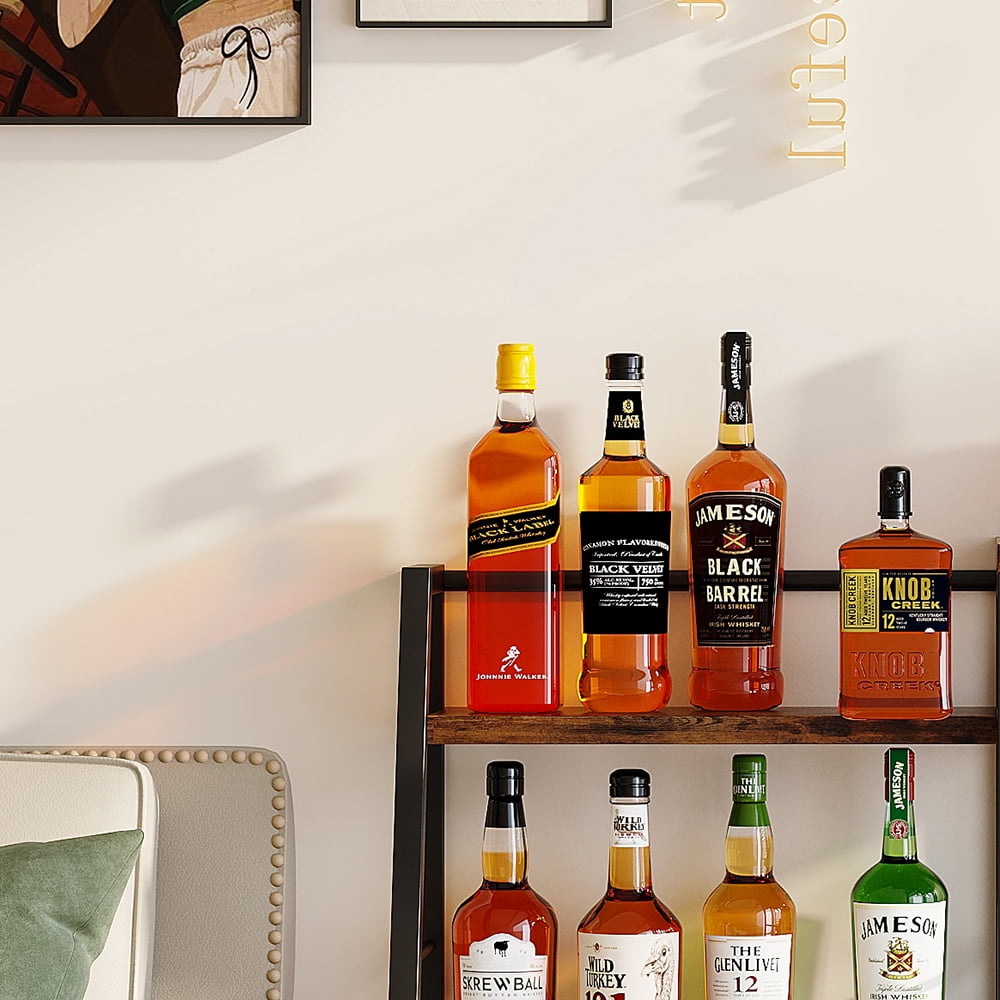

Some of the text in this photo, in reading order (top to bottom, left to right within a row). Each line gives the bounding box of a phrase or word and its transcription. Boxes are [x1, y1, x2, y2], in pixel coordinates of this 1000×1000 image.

[731, 344, 741, 390] JAMESON
[695, 504, 774, 527] JAMESON
[511, 519, 554, 532] LABEL
[589, 565, 630, 574] BLACK
[707, 558, 762, 576] BLACK
[641, 577, 654, 586] 750
[883, 577, 932, 601] KNOB
[706, 585, 764, 603] BARREL
[847, 575, 857, 626] KNOB CREEK
[891, 601, 941, 610] CREEK
[861, 616, 871, 626] 12
[882, 613, 895, 629] 12
[850, 651, 925, 680] KNOB
[892, 761, 905, 810] JAMESON
[616, 815, 642, 824] WILD
[861, 916, 938, 940] JAMESON
[730, 945, 761, 957] THE
[588, 955, 614, 973] WILD
[714, 957, 780, 973] GLENLIVET
[585, 968, 626, 989] TURKEY
[733, 975, 758, 993] 12
